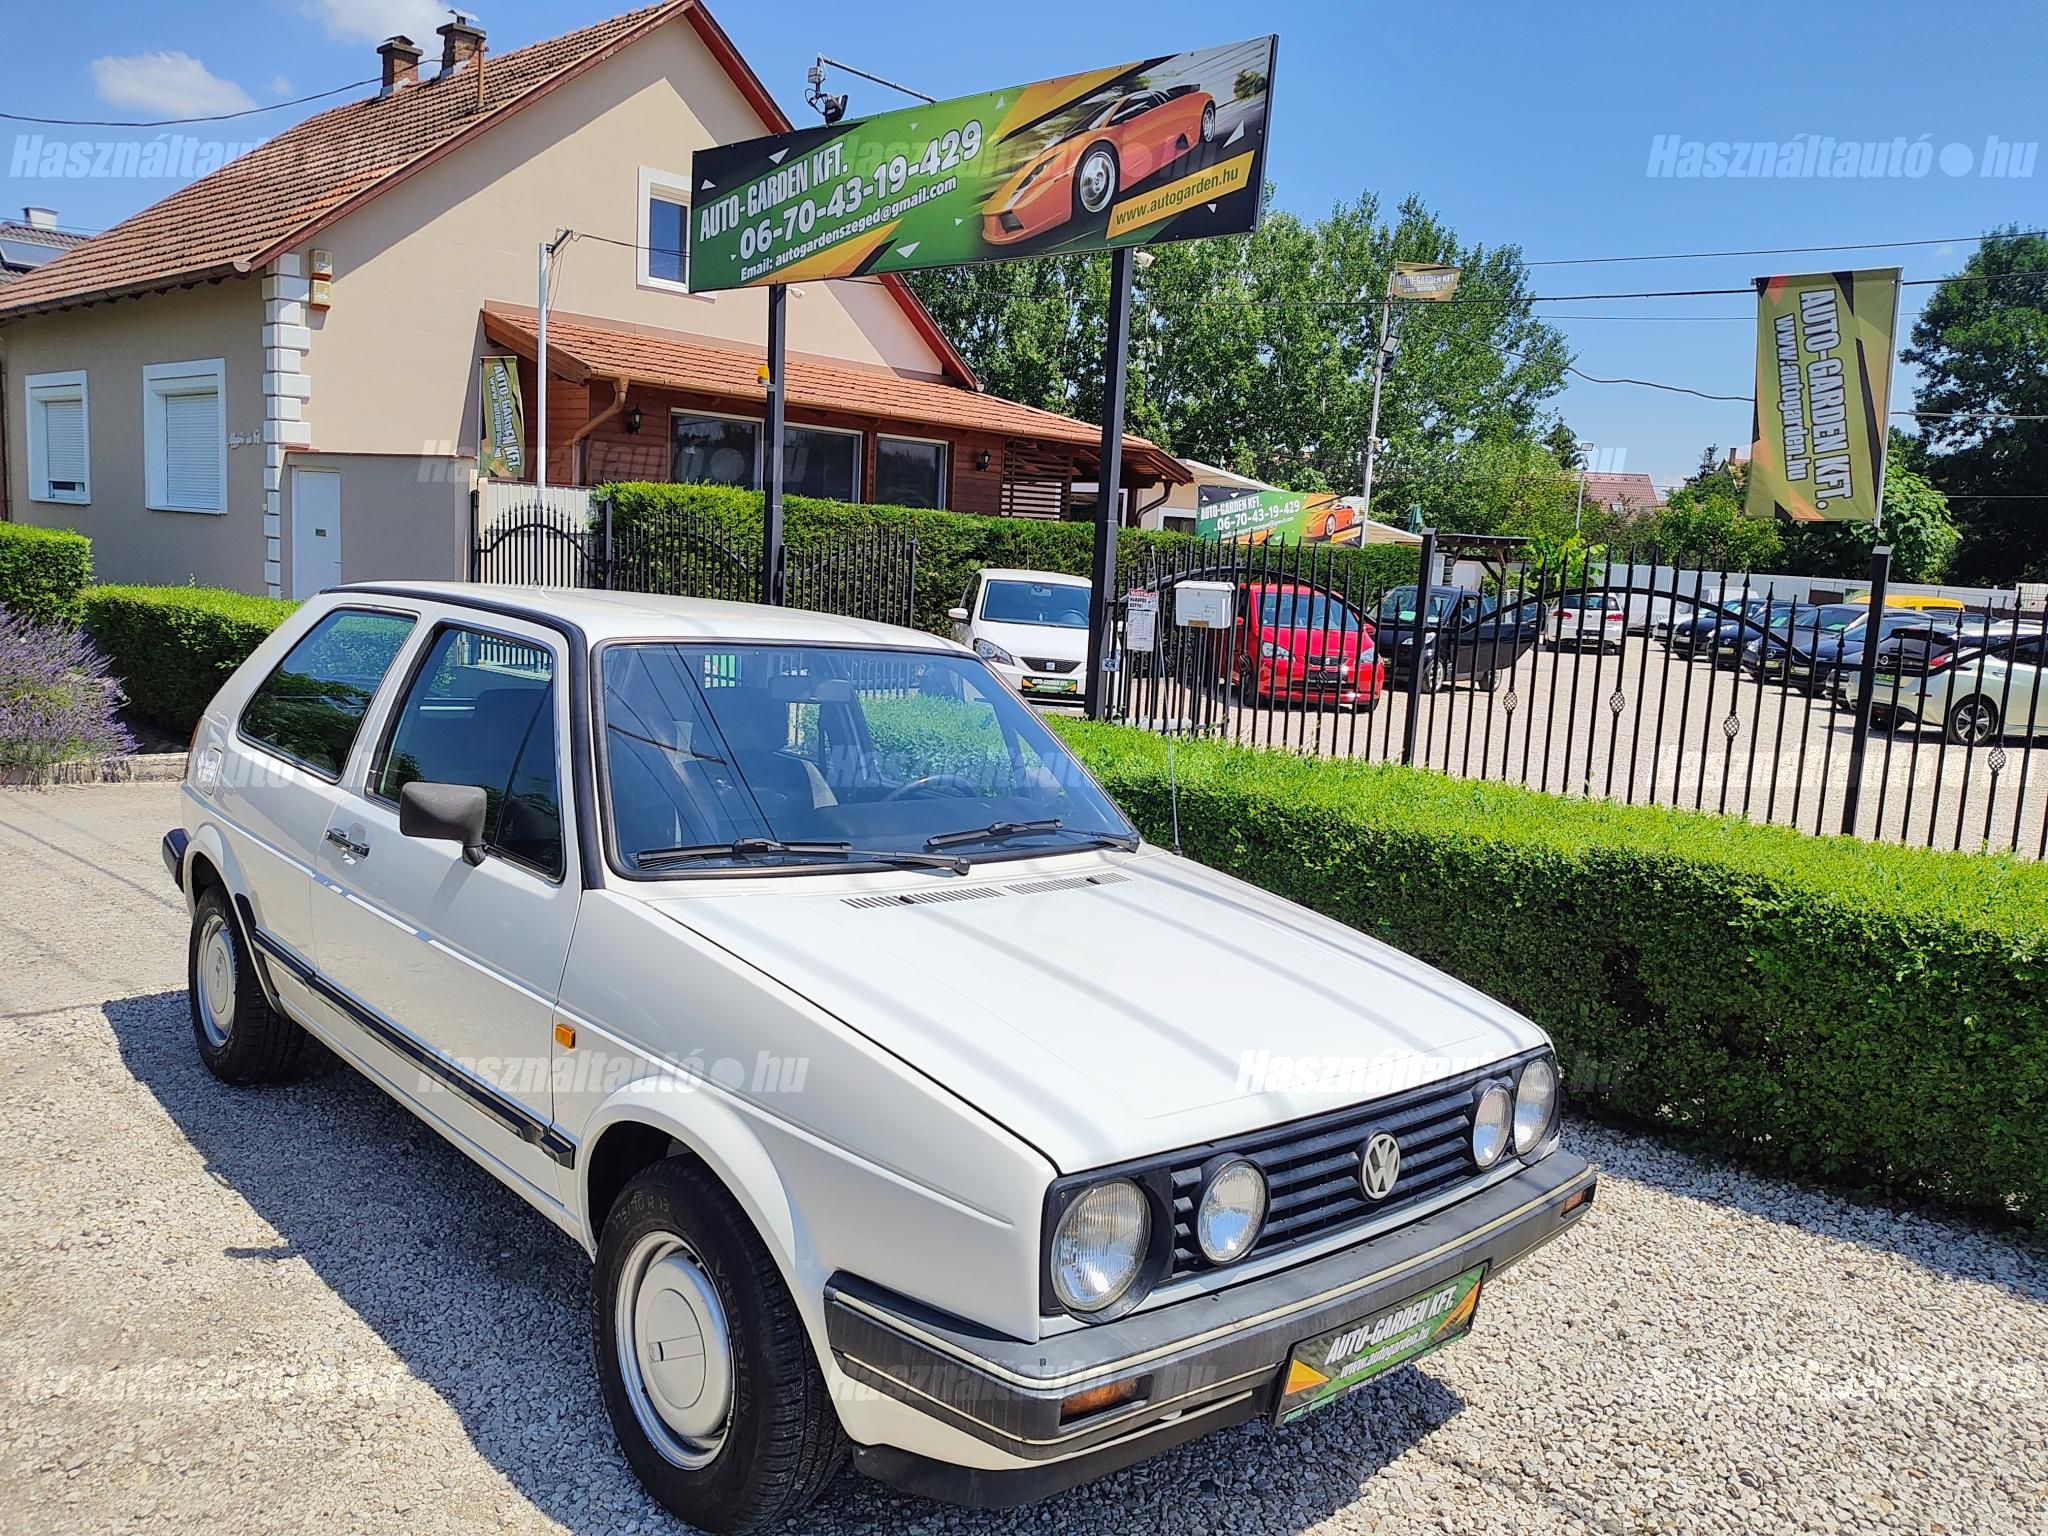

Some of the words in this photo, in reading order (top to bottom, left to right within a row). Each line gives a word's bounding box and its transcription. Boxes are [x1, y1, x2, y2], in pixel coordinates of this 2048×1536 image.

[700, 160, 809, 241] AUTO-GARDEN
[812, 142, 849, 187] KFT.
[740, 119, 983, 260] 06-70-43-19-429
[740, 260, 773, 281] Email:
[775, 175, 958, 267] autogardenszeged@gmail.com
[1116, 167, 1239, 225] www.autogarden.hu
[493, 365, 518, 445] AUTO-GARDEN
[1774, 313, 1811, 482] www.autogarden.hu
[1800, 288, 1849, 454] AUTO-GARDEN
[504, 445, 521, 472] KFT.
[1814, 454, 1853, 510] KFT.
[1200, 499, 1247, 521] AUTO-GARDEN
[1248, 496, 1263, 513] KFT.
[1216, 500, 1300, 531] 06-70-43-19-429
[1324, 1298, 1429, 1365] AUTO-GARDEN
[1427, 1285, 1458, 1318] KFT.
[1340, 1325, 1431, 1379] www.autogarden.hu
